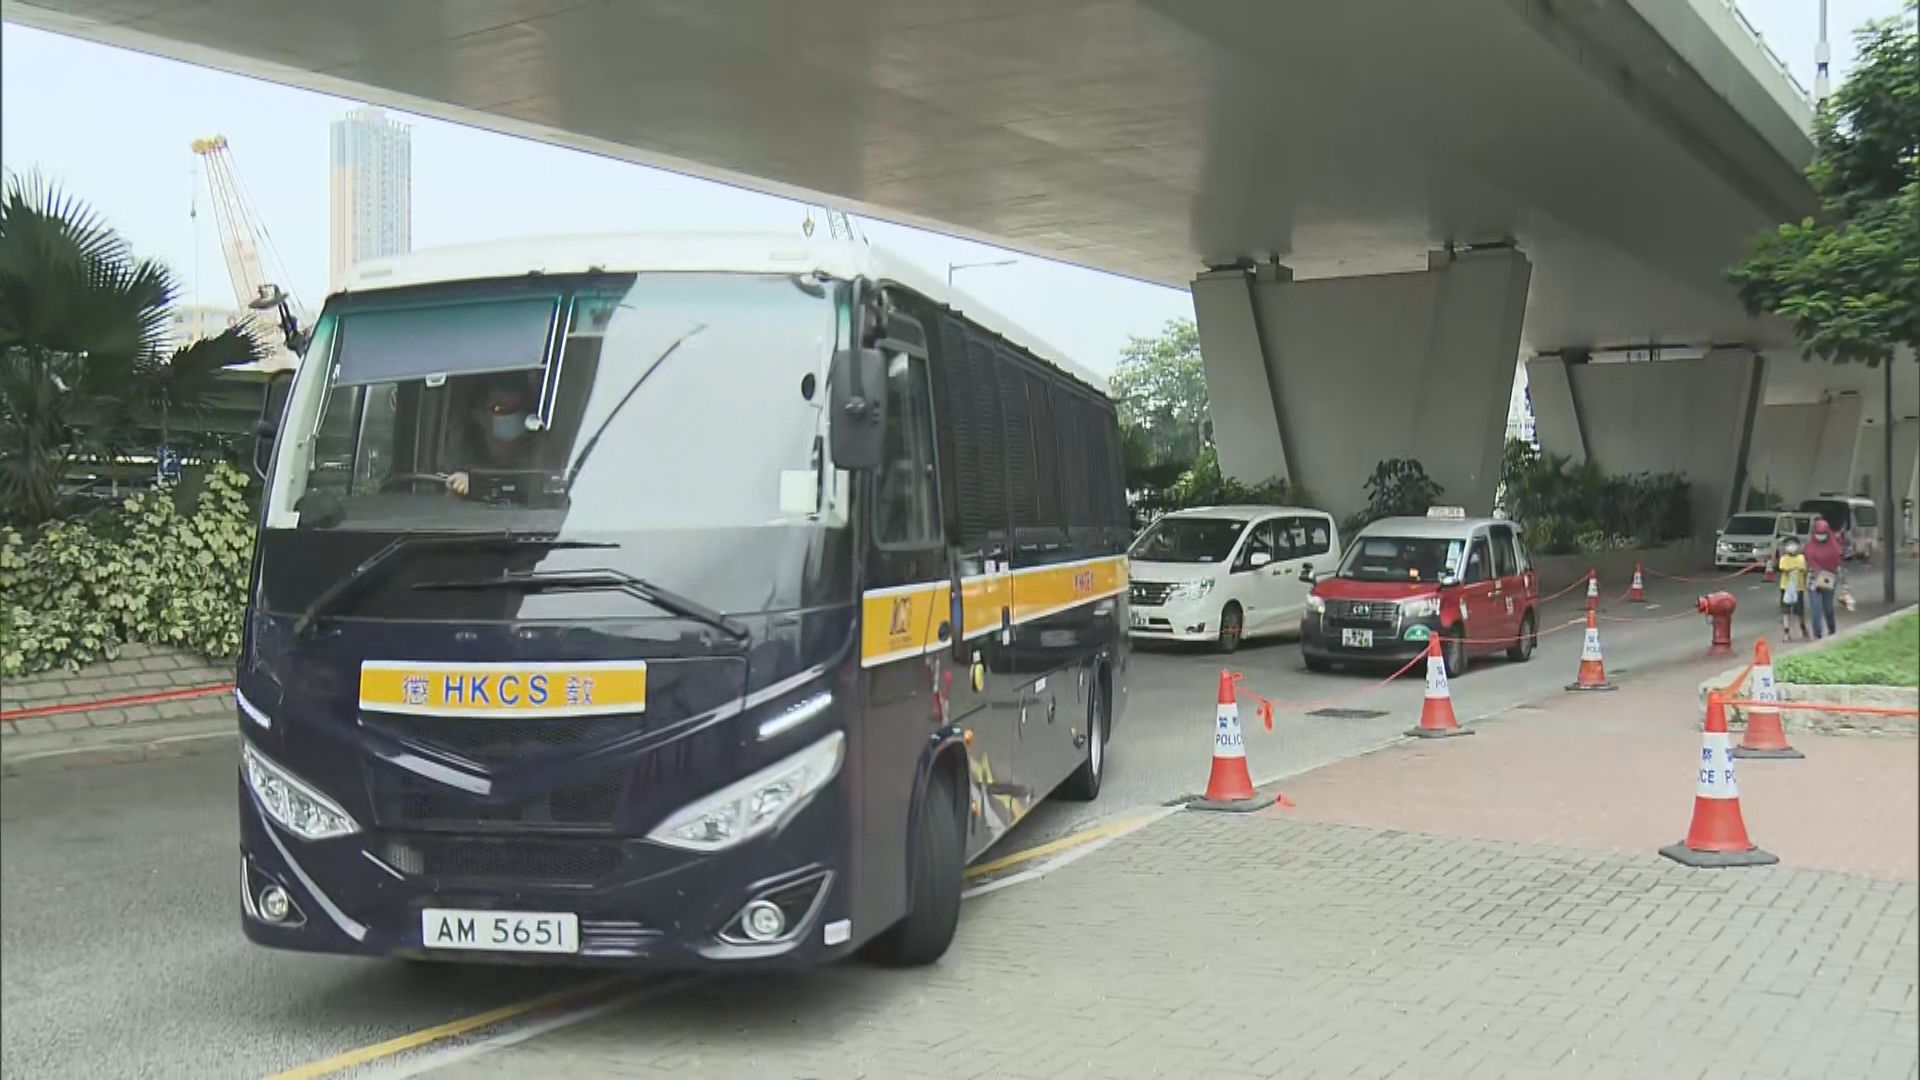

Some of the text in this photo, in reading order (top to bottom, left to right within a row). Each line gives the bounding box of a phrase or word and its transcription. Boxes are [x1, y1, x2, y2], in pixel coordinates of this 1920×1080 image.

[443, 674, 549, 705] HKCS
[1215, 734, 1244, 745] POLIC
[437, 916, 562, 947] AM 5651
